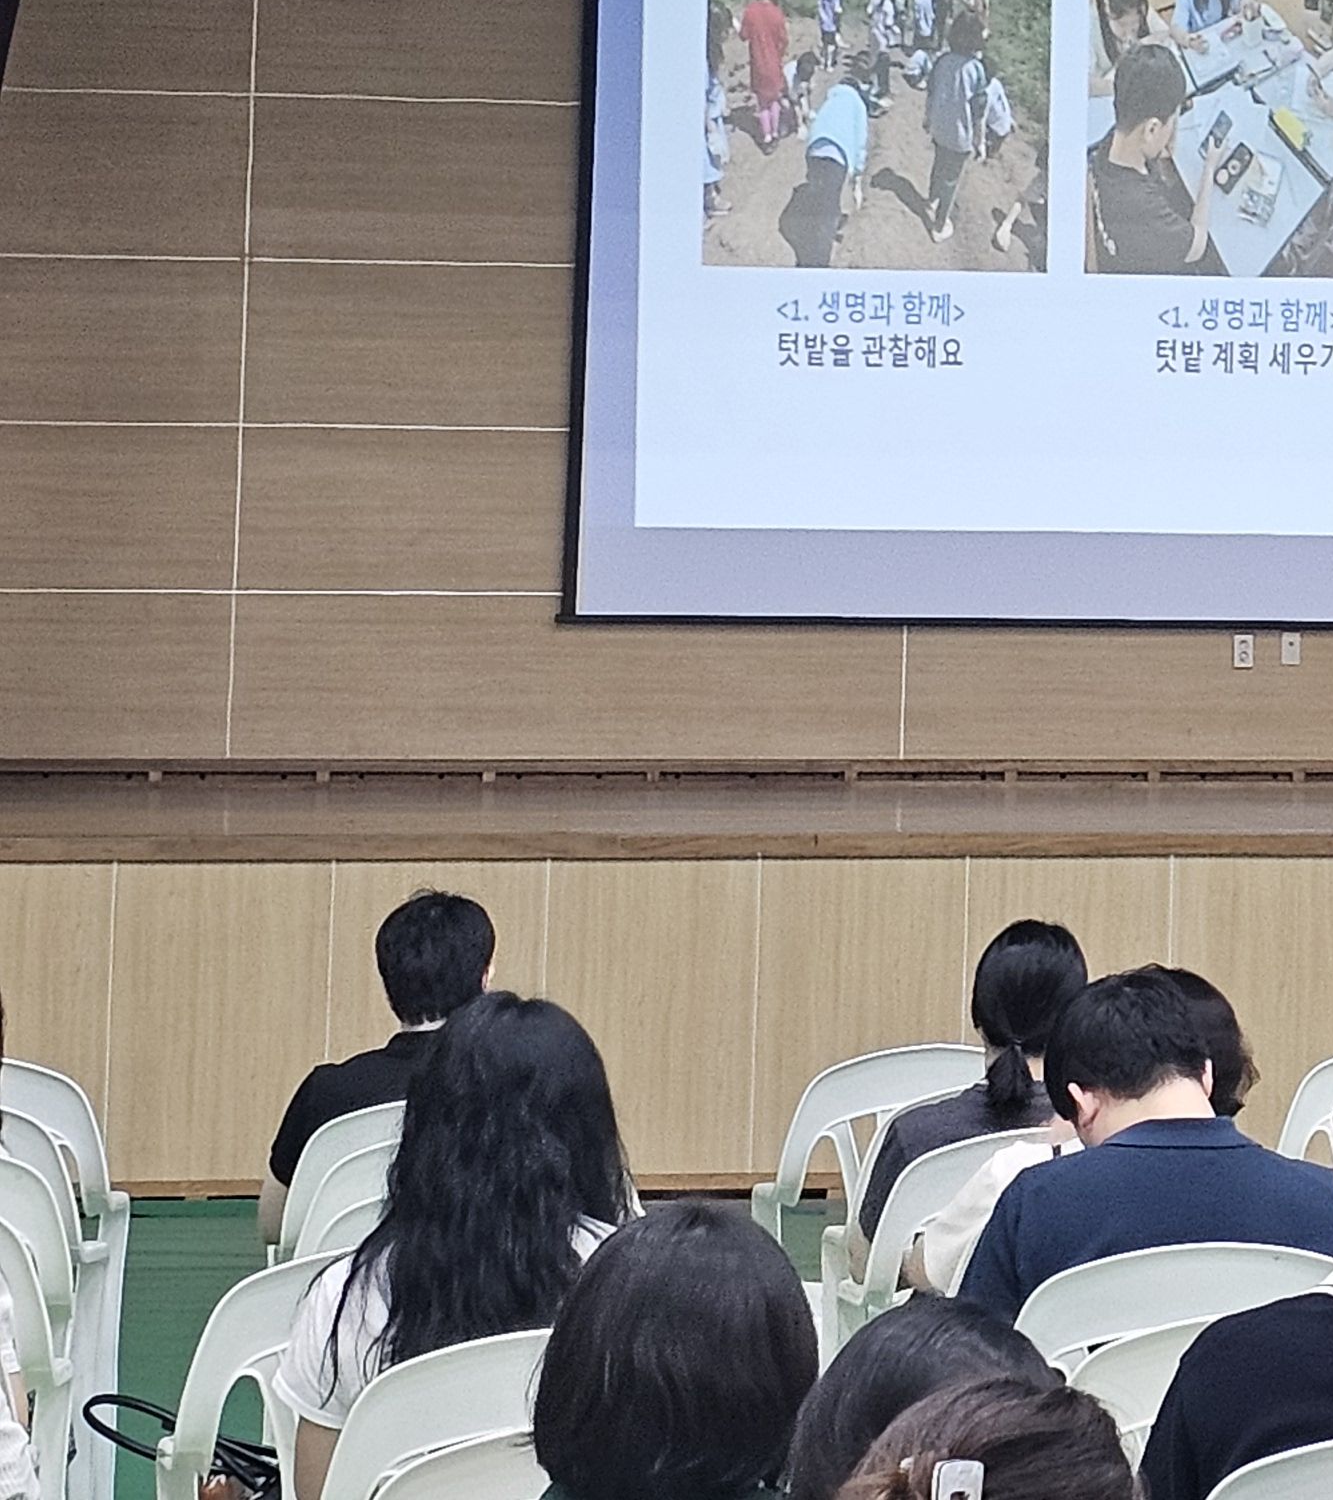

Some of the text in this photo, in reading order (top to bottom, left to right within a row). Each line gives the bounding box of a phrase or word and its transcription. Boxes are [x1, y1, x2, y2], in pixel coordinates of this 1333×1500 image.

[776, 291, 965, 327] <1. 생명과 함께>
[1158, 305, 1189, 329] <1.
[1197, 298, 1273, 334] 생명과
[778, 331, 964, 369] 텃밭을 관찰해요
[1155, 338, 1205, 374] 텃밭
[1212, 340, 1259, 375] 계획
